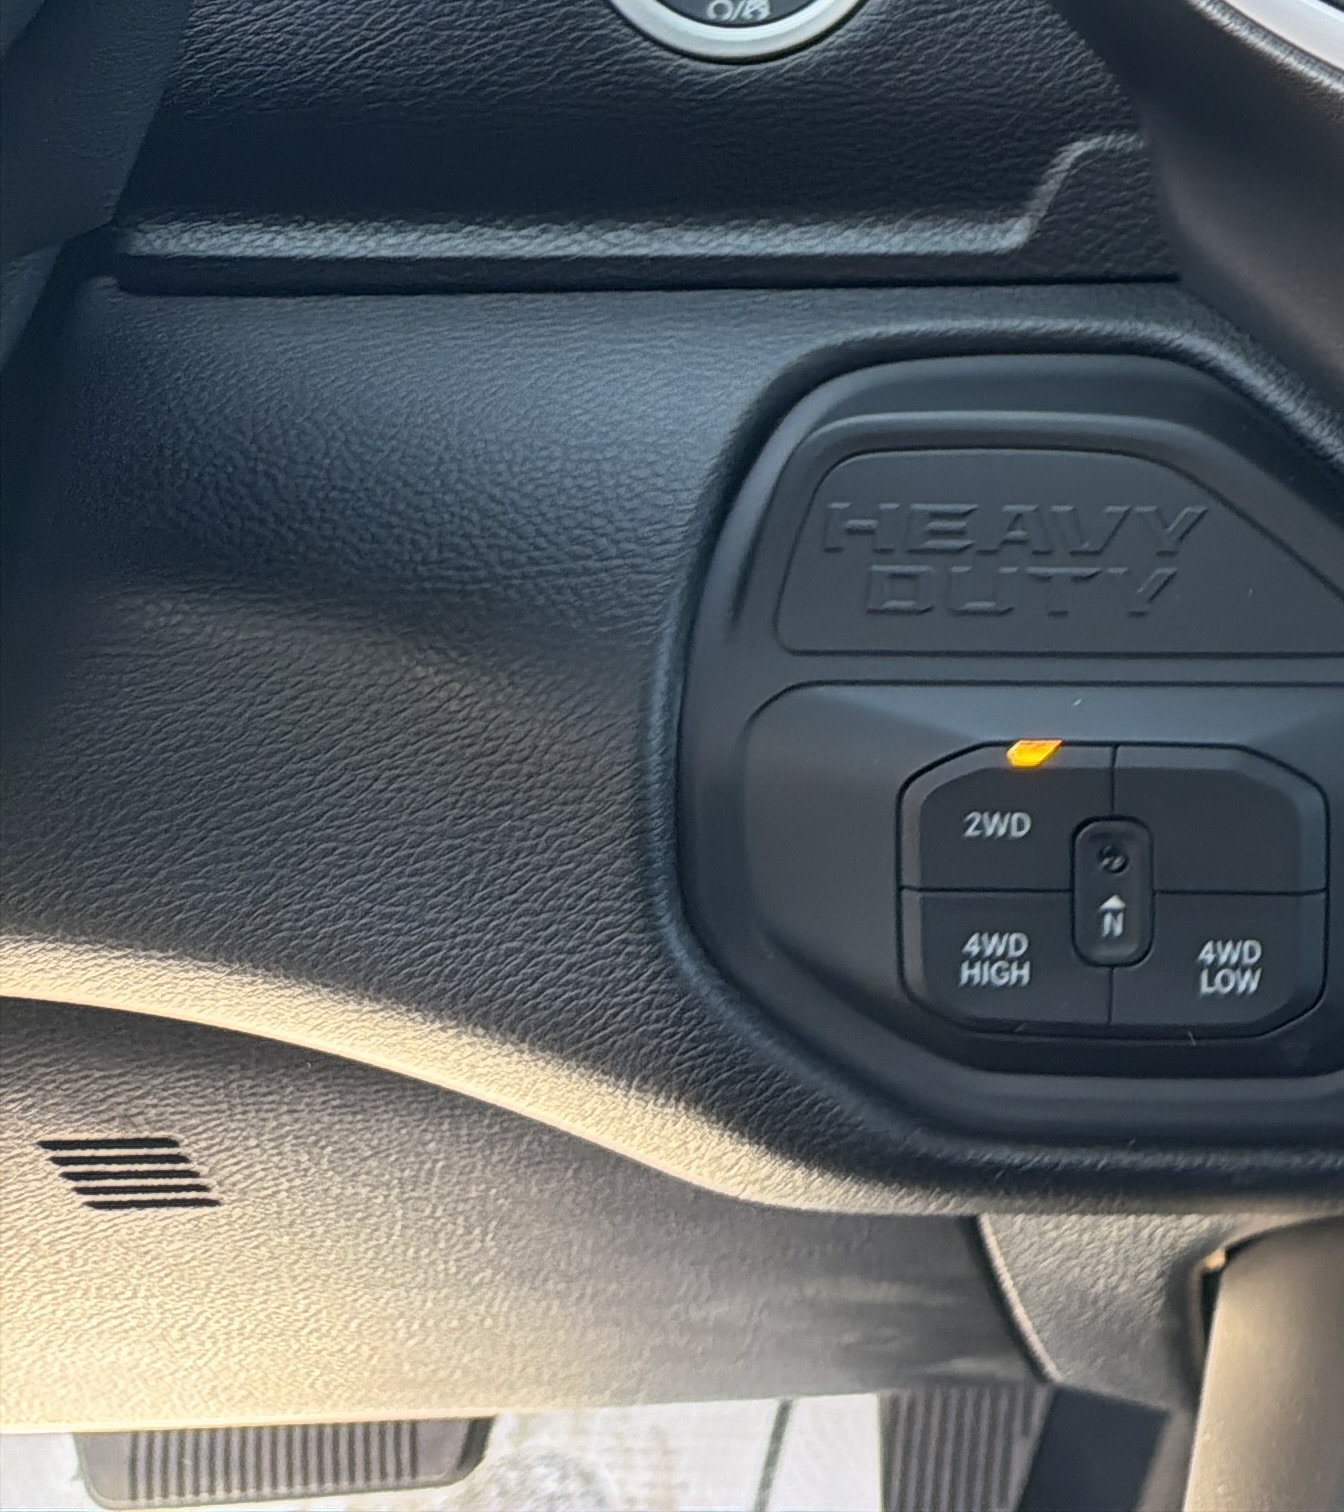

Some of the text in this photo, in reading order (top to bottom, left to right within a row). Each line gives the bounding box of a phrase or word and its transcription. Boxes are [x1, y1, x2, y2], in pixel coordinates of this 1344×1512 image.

[823, 501, 1208, 556] HEAVY
[866, 564, 1179, 618] DUTY
[962, 811, 1032, 839] 2WD
[1100, 912, 1125, 939] N
[961, 931, 1029, 959] 4WD
[1197, 939, 1262, 966] 4WD
[958, 959, 1031, 988] HIGH
[1198, 967, 1262, 997] LOW
